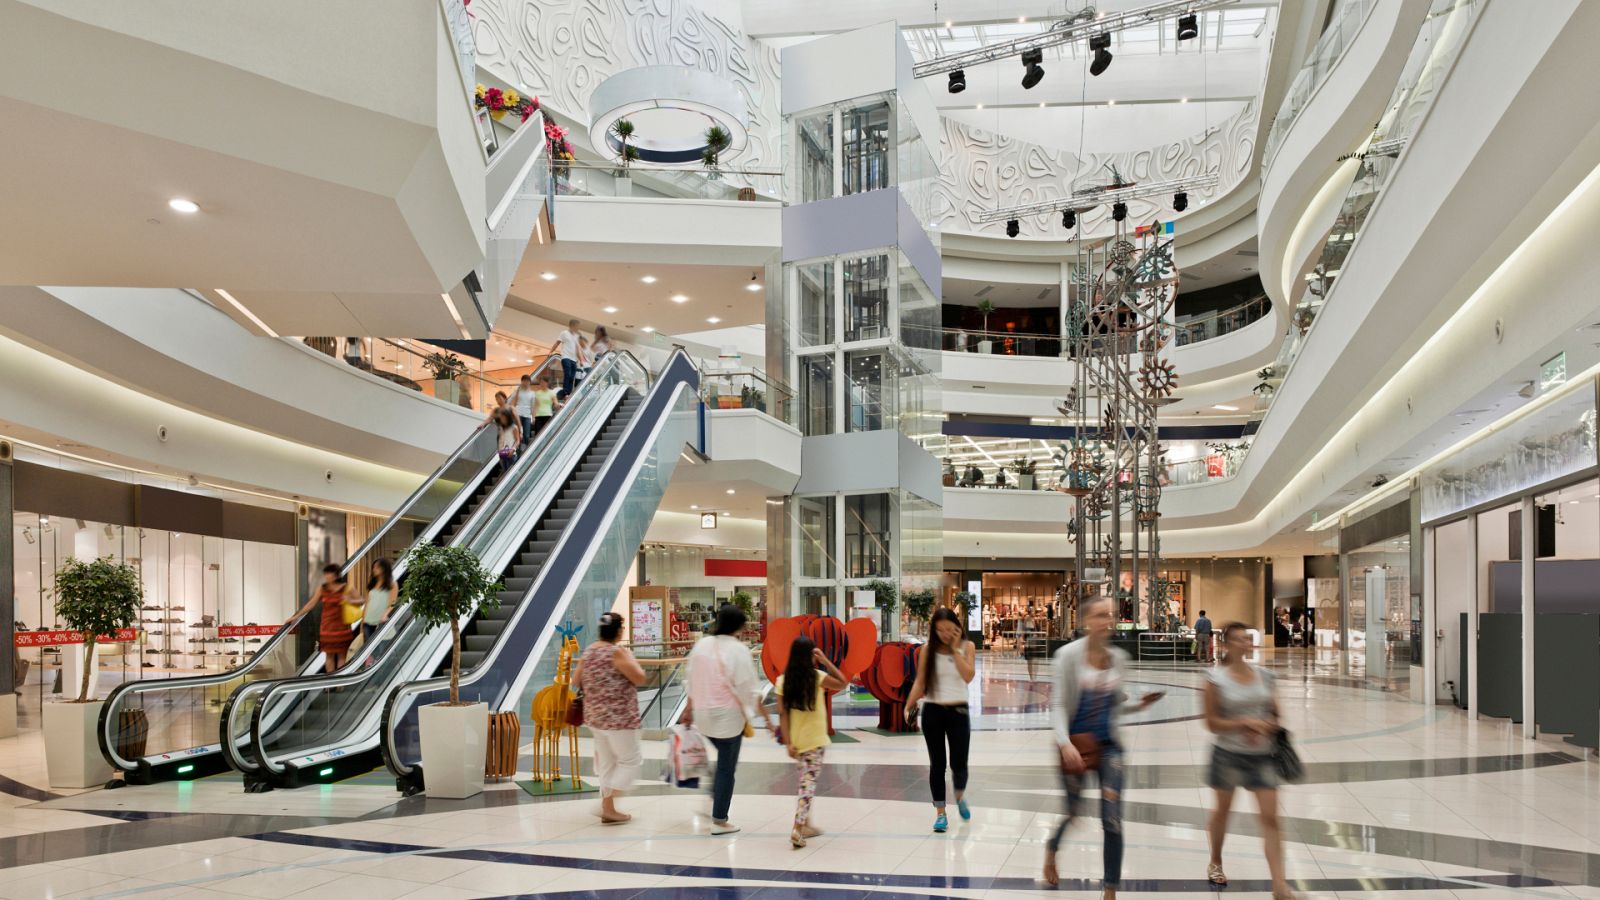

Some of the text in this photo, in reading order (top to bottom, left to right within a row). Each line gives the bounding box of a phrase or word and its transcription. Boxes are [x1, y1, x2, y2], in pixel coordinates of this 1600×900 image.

[15, 635, 32, 644] -50%
[35, 634, 51, 643] -30%
[52, 633, 68, 642] -40%
